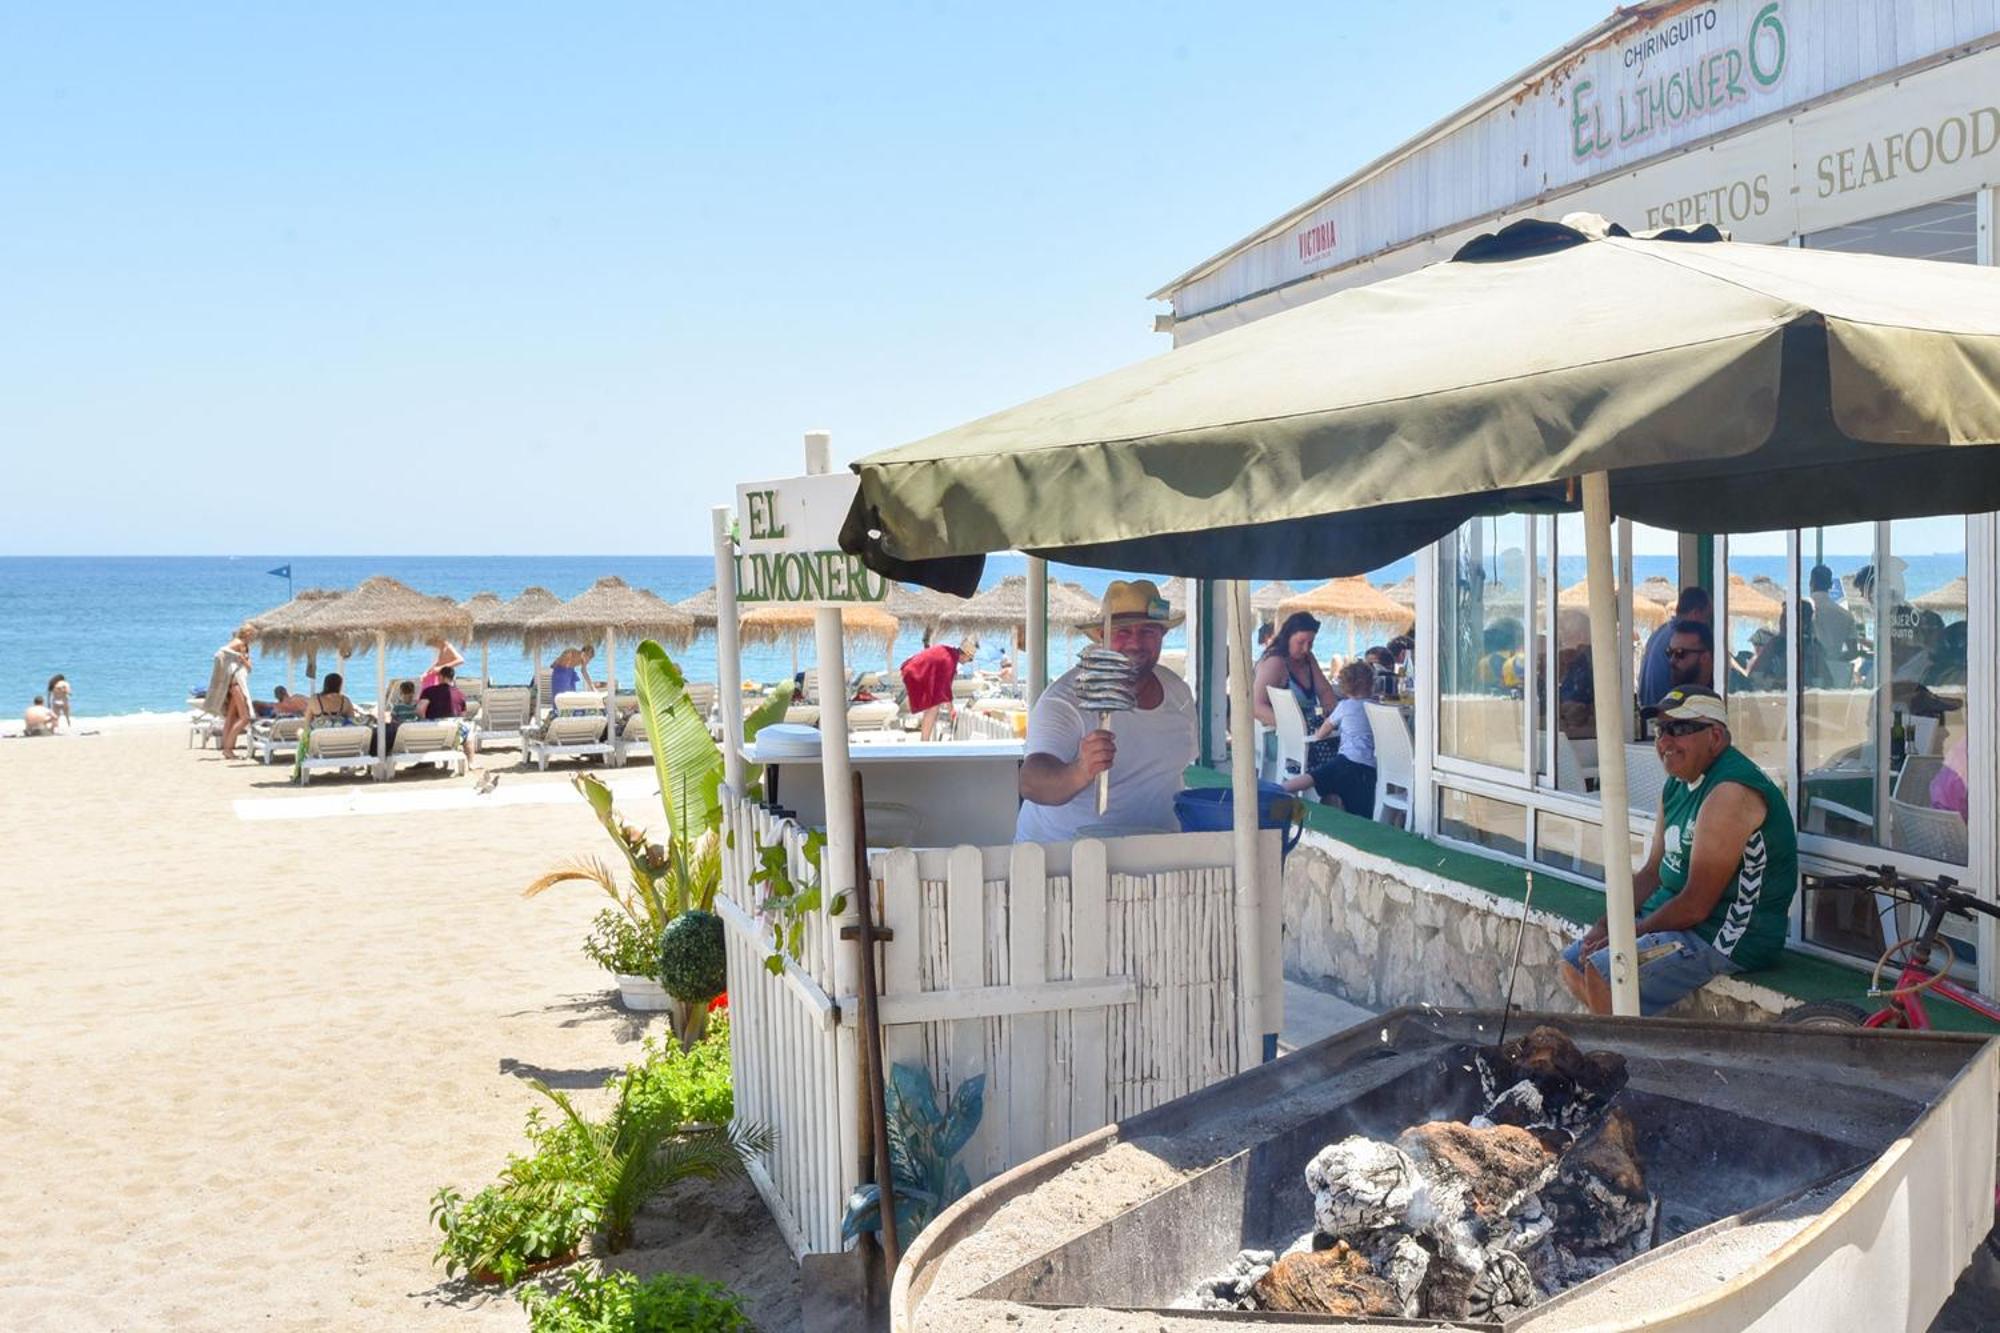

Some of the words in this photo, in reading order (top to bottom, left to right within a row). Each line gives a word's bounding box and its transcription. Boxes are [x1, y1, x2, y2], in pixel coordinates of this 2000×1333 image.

[1624, 9, 1717, 68] CHIRINGUITO
[1572, 80, 1612, 157] EL
[1619, 2, 1786, 142] LIMONERO
[1646, 174, 1770, 231] ESPETOS
[1817, 106, 2000, 198] SEAFOOD
[1298, 220, 1336, 260] VICTORIA
[746, 490, 785, 540] EL
[734, 550, 888, 602] LIMONERO
